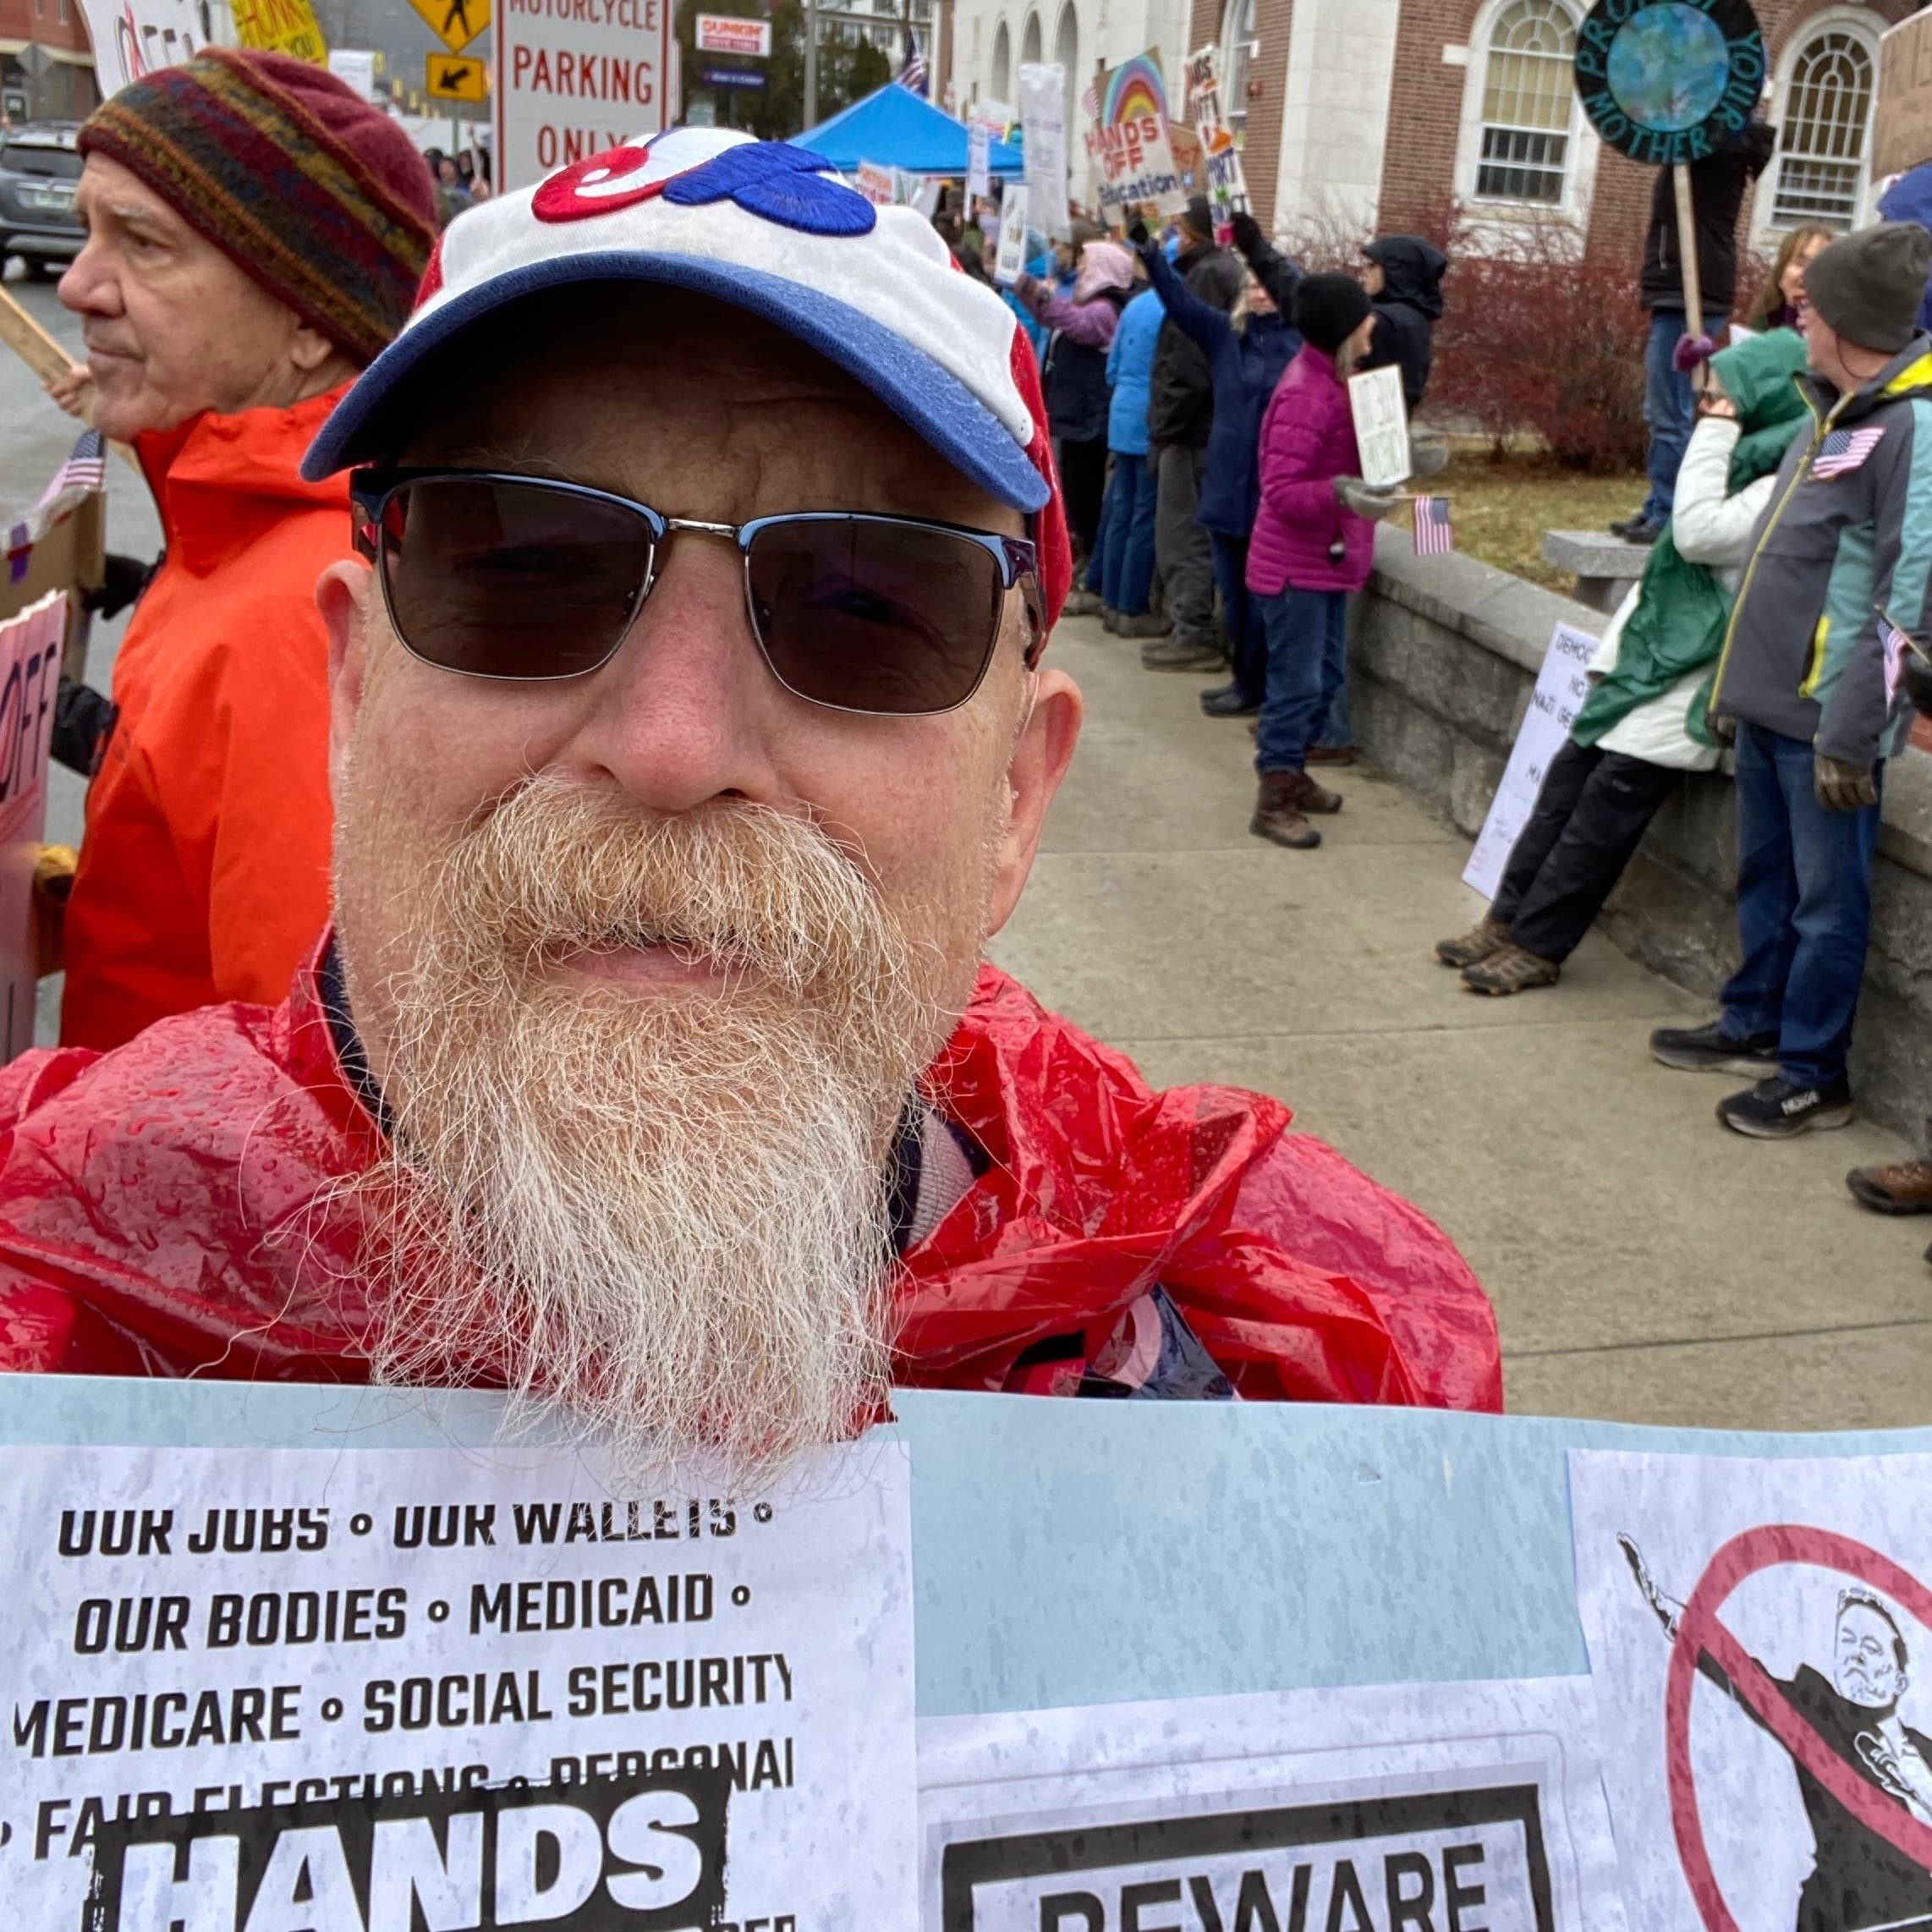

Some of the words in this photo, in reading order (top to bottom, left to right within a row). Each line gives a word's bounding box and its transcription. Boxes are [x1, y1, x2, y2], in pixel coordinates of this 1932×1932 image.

[513, 44, 654, 106] PARKING
[1085, 117, 1159, 156] HANDS
[1583, 92, 1713, 164] MOTHER
[1102, 146, 1144, 182] OFF
[58, 1509, 174, 1556] OUR
[188, 1507, 331, 1554] JOBS
[393, 1504, 496, 1549] OUR
[74, 1595, 191, 1655] OUR
[206, 1587, 408, 1649] BODIES
[469, 1573, 714, 1635] MEDICAID
[13, 1685, 302, 1759] MEDICARE
[364, 1670, 553, 1733] SOCIAL
[568, 1653, 793, 1718] SECURITY
[117, 1790, 703, 1932] HANDS
